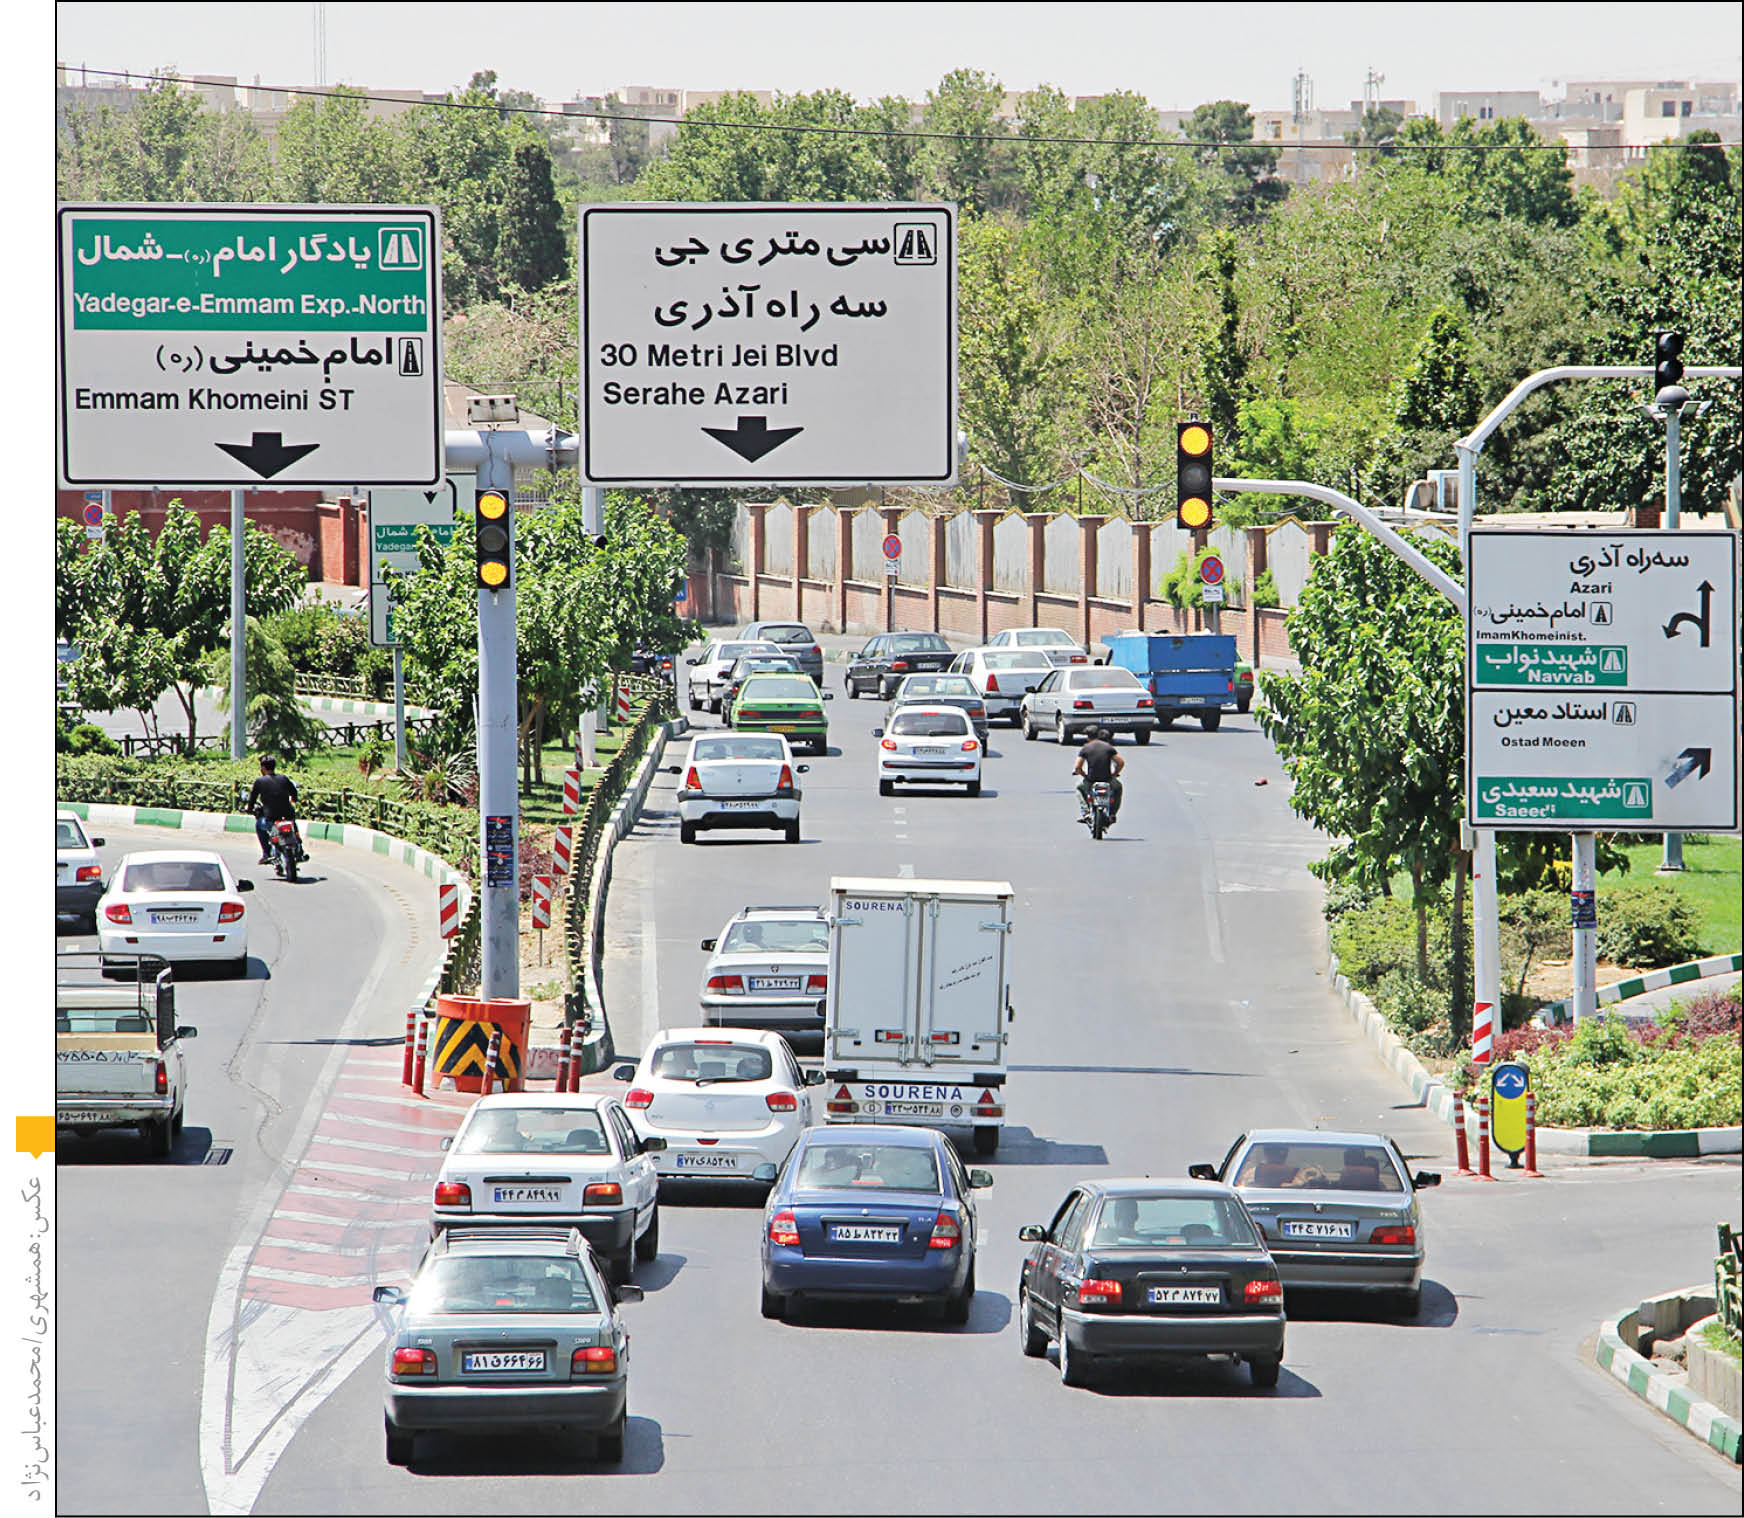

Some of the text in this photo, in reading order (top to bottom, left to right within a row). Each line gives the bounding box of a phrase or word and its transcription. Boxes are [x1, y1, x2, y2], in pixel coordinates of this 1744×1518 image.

[280, 233, 371, 274] یادگار
[654, 236, 710, 267] جی
[826, 236, 890, 267] سی
[74, 292, 295, 318] Yadegar-e-Emmam
[654, 284, 888, 332] سه راه آذری
[209, 339, 320, 374] خمینی
[323, 337, 393, 376] امام
[600, 344, 838, 367] 30 Metri Jei Blvd
[75, 388, 355, 410] Emmam Khomeini ST
[603, 383, 788, 406] Serahe Azari
[1570, 544, 1625, 577] آذری
[1570, 582, 1613, 594] Azari
[1491, 602, 1550, 625] خمینی
[1485, 645, 1598, 673] شهید نواب
[1528, 669, 1596, 685] Navvab
[1493, 701, 1607, 727] استاد معین
[1501, 736, 1586, 747] Ostad Moeen
[1482, 778, 1622, 805] شهید سعیدی
[846, 901, 904, 912] SOURENA
[864, 1085, 963, 1100] SOURENA
